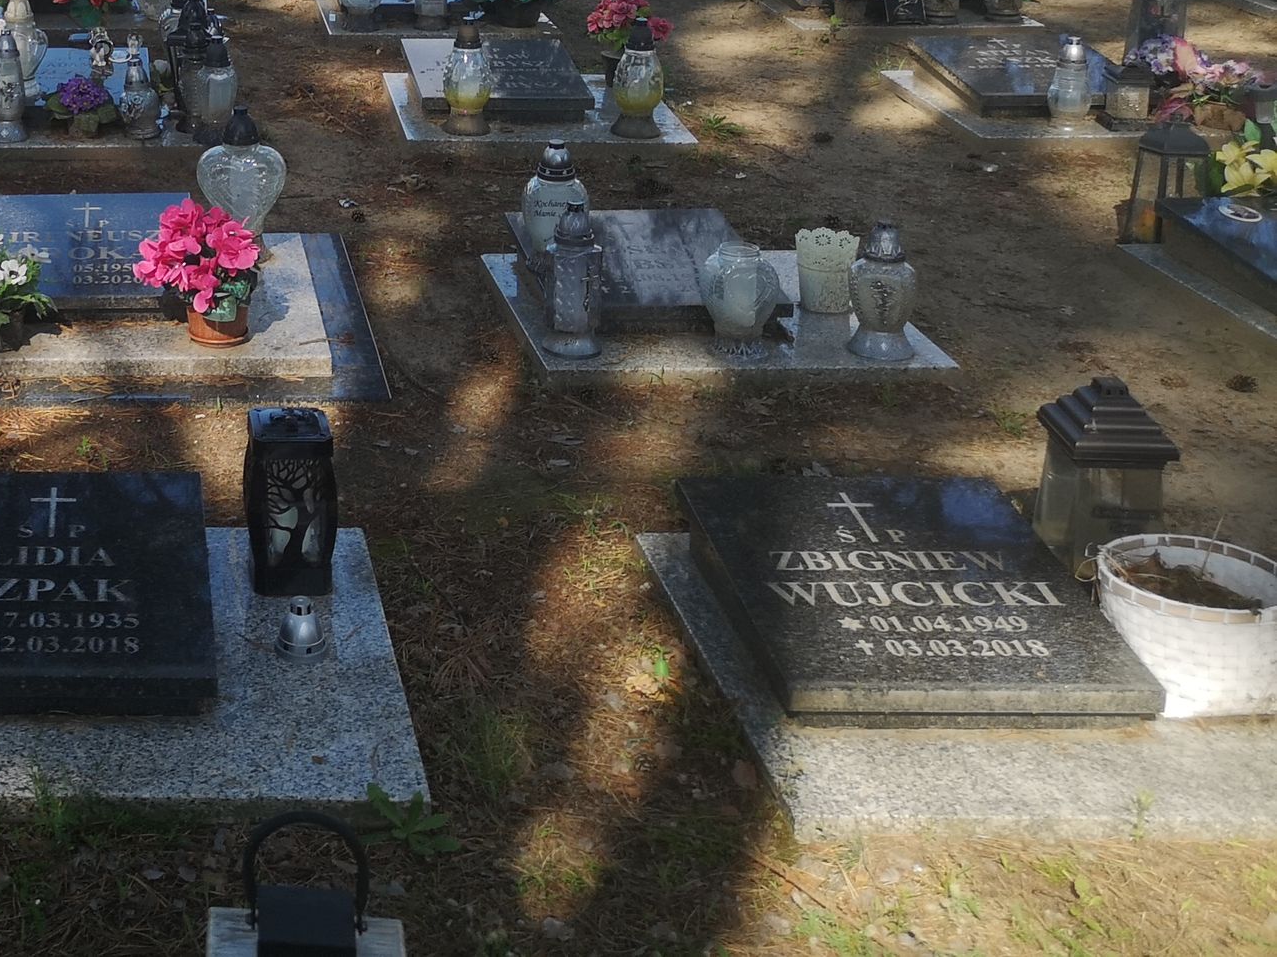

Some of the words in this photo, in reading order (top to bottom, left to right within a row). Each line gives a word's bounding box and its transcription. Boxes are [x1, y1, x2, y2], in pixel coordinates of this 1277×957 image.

[68, 524, 87, 539] P
[886, 528, 906, 544] P
[769, 550, 1006, 572] ZBIGNIEW
[766, 580, 1067, 607] WUJCICKI
[869, 615, 1029, 634] 01.04.1949
[885, 639, 1050, 658] 03.03.2018
